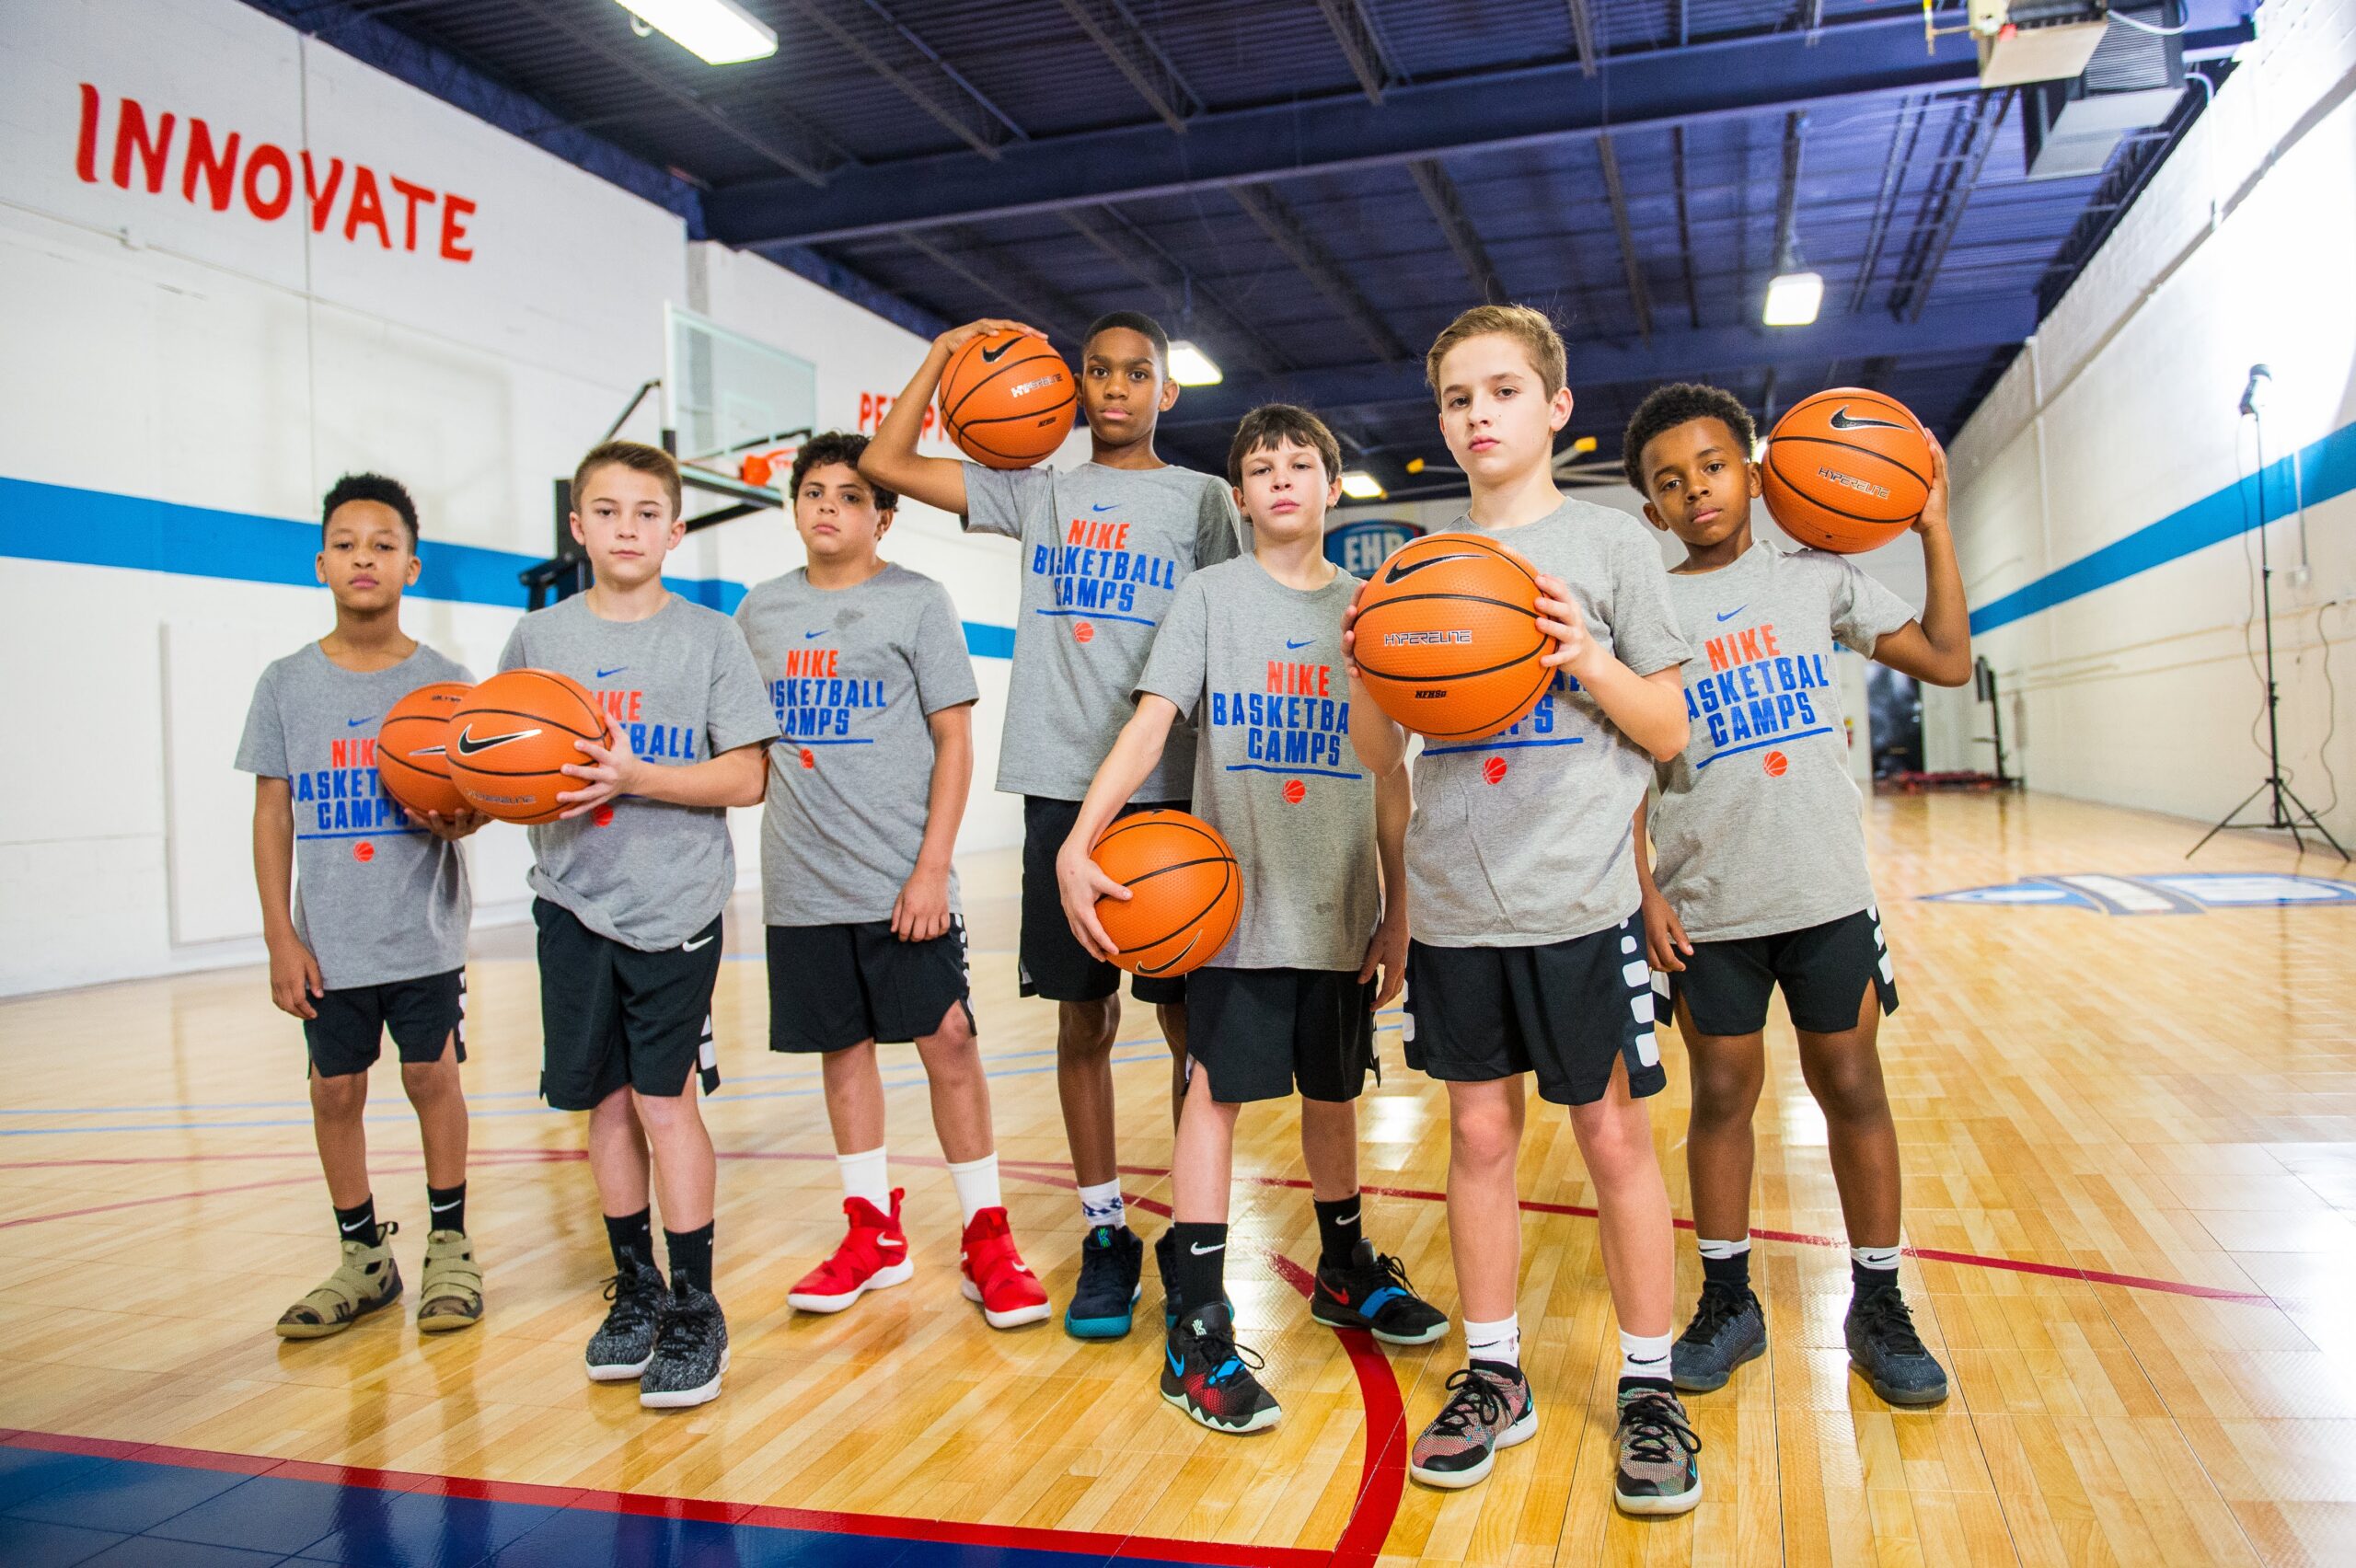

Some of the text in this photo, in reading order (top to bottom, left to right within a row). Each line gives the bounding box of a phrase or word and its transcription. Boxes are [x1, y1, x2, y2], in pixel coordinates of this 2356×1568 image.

[75, 83, 477, 263] INNOVATE
[1067, 519, 1130, 550] NIKE
[1383, 629, 1472, 646] HYPERELITE
[1704, 623, 1781, 673] NIKE
[786, 650, 838, 678] NIKE
[1266, 661, 1331, 698] NIKE
[769, 679, 887, 708] SKETBALL
[1683, 653, 1830, 722] ASKETBAL
[592, 690, 642, 721] IKE
[1212, 692, 1350, 735] BASKETBA
[1707, 691, 1817, 748] CAMPS
[331, 738, 375, 768] NIK
[1247, 727, 1341, 767] CAMPS
[289, 767, 379, 801] ASKET
